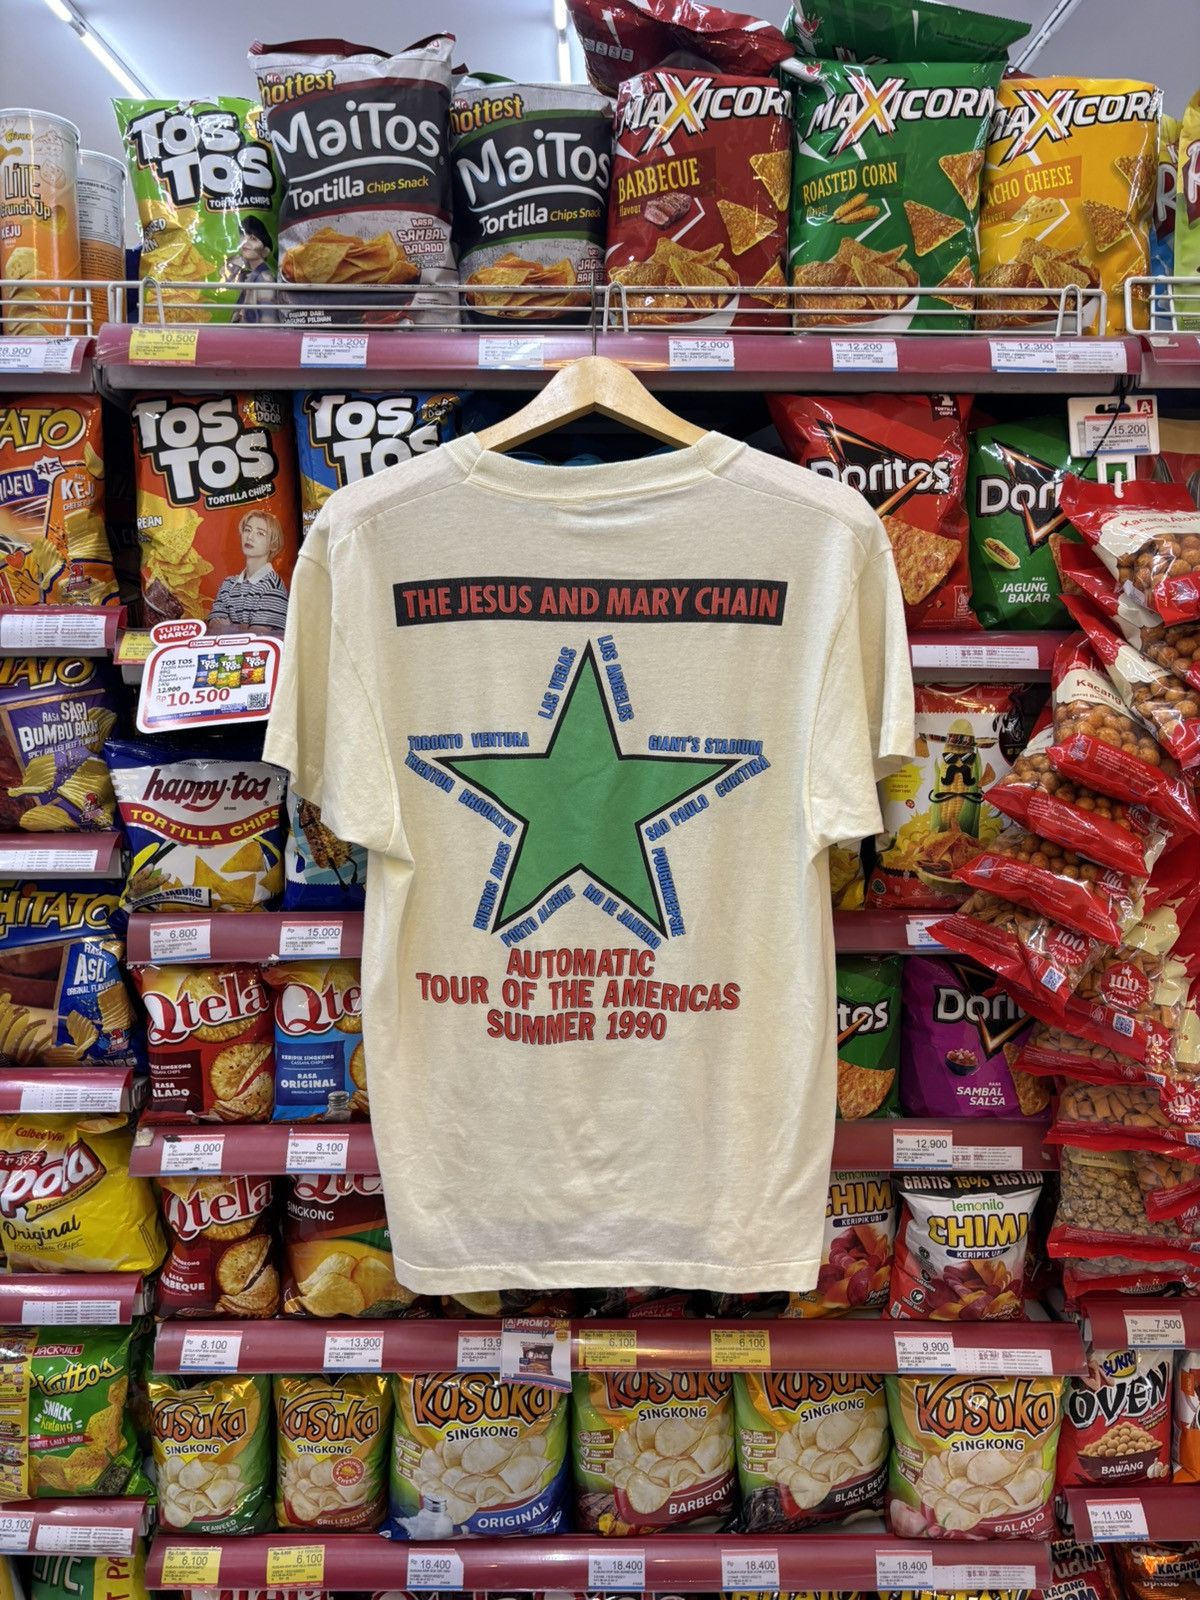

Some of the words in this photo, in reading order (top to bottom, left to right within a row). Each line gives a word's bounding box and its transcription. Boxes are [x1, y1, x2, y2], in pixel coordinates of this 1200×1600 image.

[258, 70, 335, 106] hottest
[130, 110, 241, 160] TOS
[161, 146, 273, 201] TOS
[618, 157, 700, 203] BARBECUE
[1024, 165, 1073, 193] CHEESE
[803, 169, 858, 205] ROASTED
[862, 161, 898, 187] CORN
[250, 196, 271, 207] CHIPS
[289, 177, 364, 210] Tortilla
[367, 179, 396, 193] Chips
[398, 176, 429, 190] Snack
[479, 203, 548, 236] Tortilla
[550, 210, 577, 222] Chips
[398, 228, 447, 242] SAMBAL
[404, 242, 445, 255] BALADO
[161, 334, 196, 343] 10.500
[330, 338, 367, 347] 13.200
[695, 340, 730, 349] 12.000
[847, 342, 883, 351] 12.200
[1018, 342, 1053, 351] 12.300
[132, 398, 239, 449] TOS
[310, 394, 415, 439] TOS
[0, 407, 87, 452] ATO
[1112, 424, 1147, 435] 15.200
[158, 432, 275, 499] TOS
[207, 490, 247, 505] TORTILLA
[248, 483, 272, 497] CHIPS
[1000, 581, 1049, 594] JAGUNG
[402, 588, 452, 619] THE
[457, 585, 532, 616] JESUS
[539, 585, 600, 616] AND
[605, 585, 689, 616] MARY
[695, 586, 779, 618] CHAIN
[1008, 593, 1051, 604] BAKAR
[157, 624, 198, 634] TURUN
[158, 631, 198, 640] HARGA
[597, 634, 618, 662] LOS
[548, 646, 577, 691] VEGAS
[166, 688, 231, 707] 10.500
[605, 663, 635, 722] ANGELES
[1076, 679, 1122, 706] Kacang
[42, 712, 60, 722] RASA
[61, 701, 88, 722] SAPI
[538, 691, 560, 720] LAS
[407, 733, 463, 751] TORONTO
[471, 731, 529, 748] VENTURA
[704, 737, 764, 756] STADIUM
[28, 749, 45, 758] SPICY
[404, 750, 456, 793] TRENTON
[458, 788, 518, 838] BROOKLYN
[645, 818, 671, 841] SAO
[669, 793, 710, 826] PAULO
[714, 754, 771, 798] CURITIBA
[130, 809, 222, 842] TORTILLA
[229, 808, 281, 838] CHIPS
[472, 880, 500, 931] BUENOS
[489, 840, 512, 881] AIRES
[651, 846, 686, 938] POUGHKEEPSIE
[500, 916, 539, 948] PORTO
[536, 884, 577, 924] ALEGRE
[582, 883, 606, 906] RIO
[601, 897, 620, 917] DE
[616, 908, 662, 950] JANEIRO
[169, 928, 198, 939] 6.800
[307, 928, 341, 937] 15.000
[1055, 930, 1086, 952] 100
[74, 953, 107, 985] ASLI
[506, 948, 656, 980] AUTOMATIC
[415, 971, 489, 1005] TOUR
[501, 978, 538, 1010] OF
[548, 979, 595, 1010] THE
[602, 979, 741, 1013] AMERICAS
[1109, 975, 1140, 992] 100
[142, 971, 270, 1044] Qtela
[486, 1008, 596, 1045] SUMMER
[605, 1010, 668, 1041] 1990
[281, 1079, 336, 1088] ORIGINAL
[956, 1086, 1004, 1096] SAMBAL
[969, 1096, 1006, 1106] SALSA
[193, 1143, 222, 1153] 8.000
[316, 1142, 344, 1152] 8.100
[916, 1139, 948, 1149] 12.900
[903, 1174, 951, 1190] GRATIS
[953, 1174, 990, 1189] 15%
[994, 1172, 1044, 1187] EKSTRA
[164, 1174, 273, 1241] Qtela
[287, 1201, 335, 1221] SINGKONG
[952, 1199, 1004, 1212] lemonilo
[842, 1217, 869, 1226] KERIPIK
[870, 1216, 882, 1224] UBI
[3, 1214, 82, 1246] Original
[928, 1213, 1029, 1249] CHIMI
[957, 1250, 990, 1259] KERIPIK
[516, 1319, 550, 1328] PROMO
[1154, 1319, 1182, 1330] 7.500
[200, 1339, 228, 1350] 8.100
[349, 1338, 381, 1348] 13.900
[608, 1338, 636, 1347] 6.100
[738, 1338, 766, 1348] 6.100
[922, 1341, 949, 1352] 9.900
[1068, 1361, 1170, 1427] OVEN
[42, 1399, 73, 1422] SNACK
[638, 1406, 708, 1422] SINGKONG
[800, 1398, 865, 1423] SINGKONG
[446, 1425, 519, 1442] SINGKONG
[165, 1444, 220, 1455] SINGKONG
[296, 1445, 352, 1455] SINGKONG
[951, 1437, 1024, 1453] SINGKONG
[1101, 1460, 1144, 1474] BAWANG
[835, 1485, 866, 1504] BLACK
[317, 1517, 350, 1526] GRILLED
[477, 1501, 550, 1529] ORIGINAL
[994, 1512, 1045, 1533] BALADO
[1101, 1509, 1132, 1520] 11.100
[1, 1519, 32, 1530] 13.100
[201, 1519, 237, 1532] SEAWEED
[181, 1555, 209, 1566] 6.100
[296, 1553, 323, 1564] 6.100
[420, 1559, 451, 1570] 18.400
[612, 1560, 643, 1570] 18.400
[745, 1560, 776, 1571] 18.400
[896, 1561, 928, 1571] 18.400
[1042, 1578, 1086, 1600] KACANG
